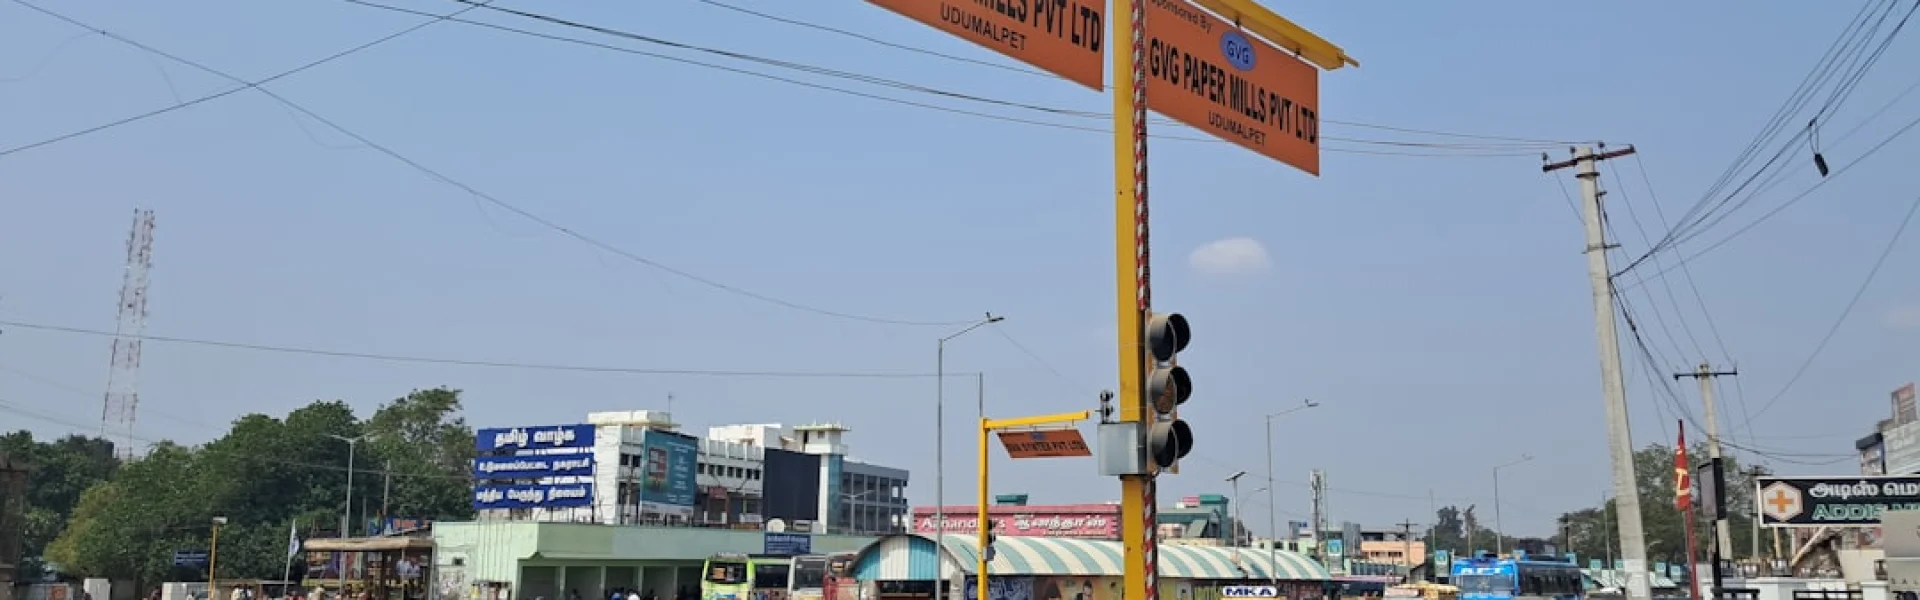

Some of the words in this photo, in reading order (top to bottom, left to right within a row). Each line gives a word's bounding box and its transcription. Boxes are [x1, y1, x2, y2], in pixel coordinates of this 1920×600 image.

[940, 3, 1027, 50] UDUMALPET
[1033, 0, 1067, 38] PVT
[1071, 1, 1100, 52] LTD
[1200, 14, 1212, 34] By
[1226, 40, 1249, 64] GVG
[1150, 37, 1180, 85] GVG
[1183, 53, 1226, 106] PAPER
[1229, 73, 1267, 123] MILLS
[1269, 92, 1292, 133] PVT
[1295, 104, 1317, 144] LTD
[1208, 111, 1267, 146] UDUMALPET
[494, 428, 528, 448] தமிழ்
[533, 427, 575, 446] வாழ்க
[553, 458, 590, 471] நகராட்சி
[476, 487, 503, 503] மத்திய
[507, 487, 544, 503] பேருந்து
[548, 486, 586, 501] நிலையம்
[1808, 480, 1880, 499] அடிஸ்
[1225, 587, 1273, 596] MKA
